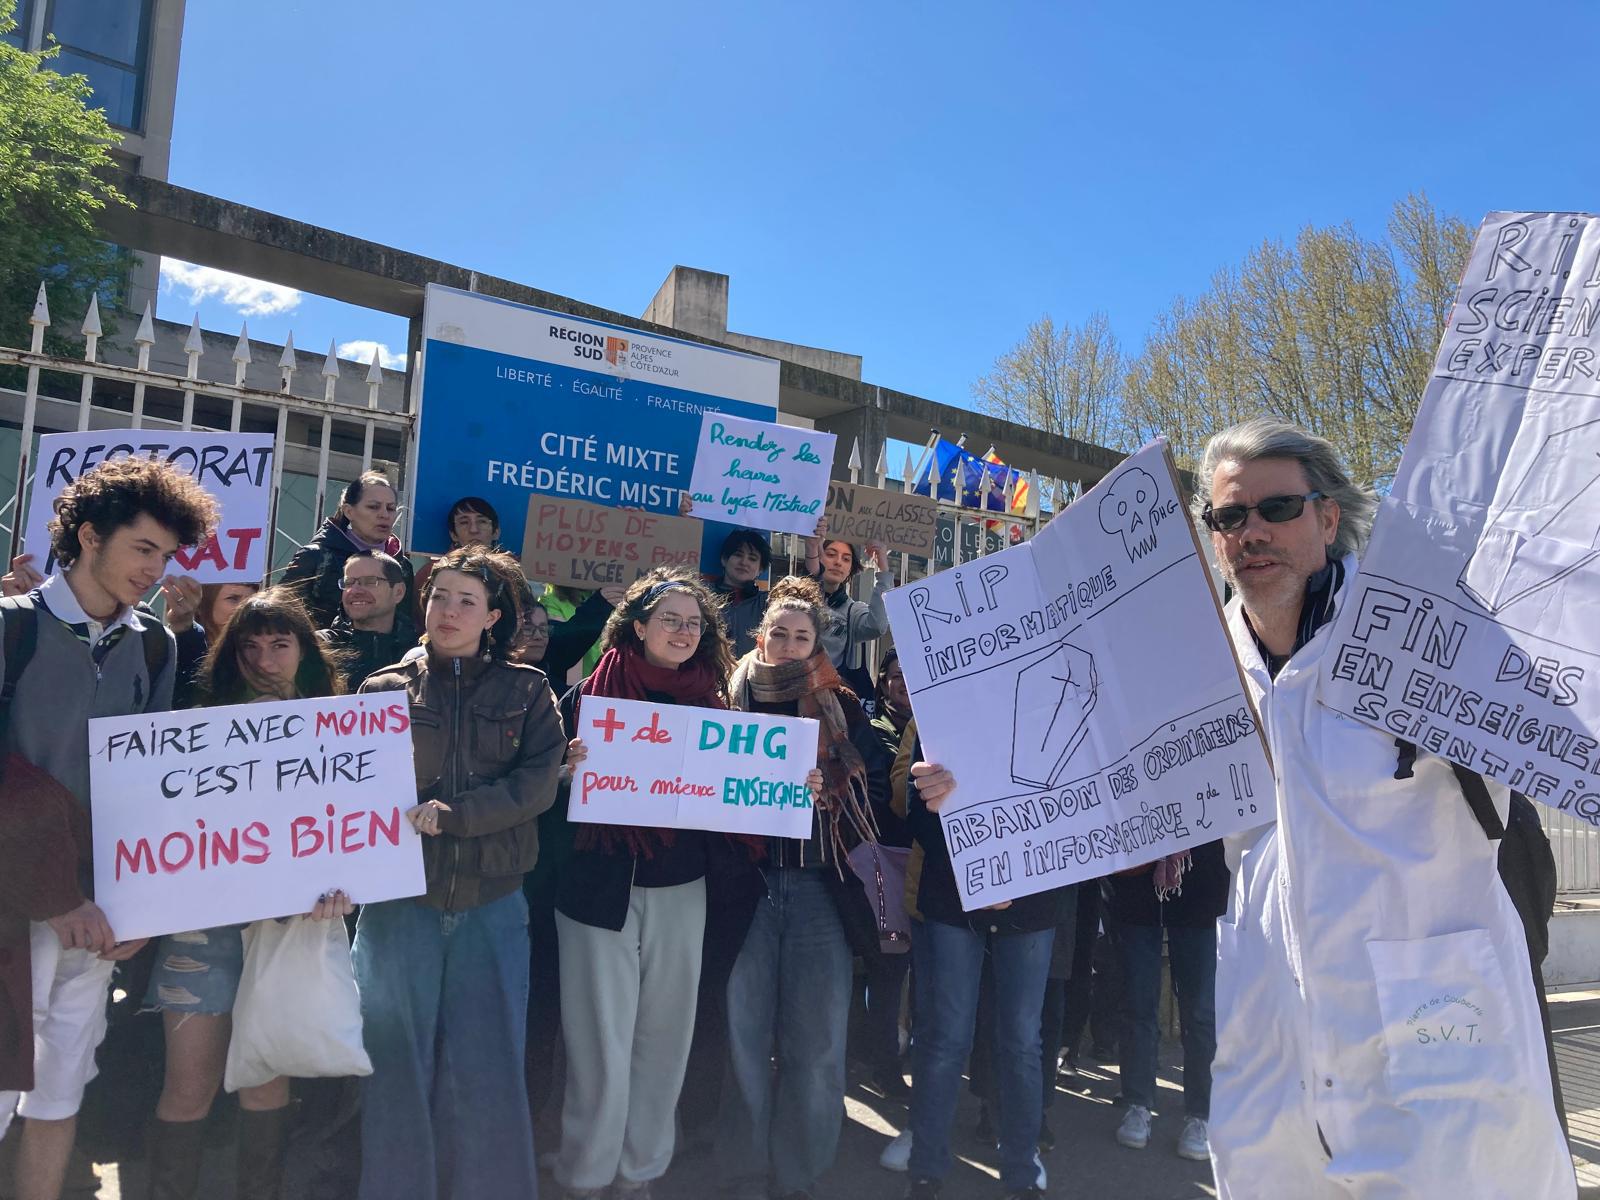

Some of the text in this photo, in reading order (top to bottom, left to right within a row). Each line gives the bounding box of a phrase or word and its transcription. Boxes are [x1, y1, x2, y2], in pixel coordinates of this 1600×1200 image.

[574, 345, 603, 361] SUD
[631, 342, 672, 359] PROVENCE
[631, 352, 653, 363] ALPES
[1447, 338, 1600, 383] EXPER
[496, 366, 552, 388] LIBERTÉ
[572, 380, 623, 401] ÉGALITÉ
[630, 360, 679, 378] CÔTE D'AZUR
[540, 432, 679, 476] CITÉ MIXTE
[710, 422, 821, 465] Rendez les
[487, 460, 611, 499] FRÉDÉRIC
[722, 459, 782, 485] heures
[692, 490, 715, 504] au
[763, 493, 821, 516] Mistral
[875, 501, 936, 526] CLASSES
[1152, 501, 1179, 527] DHG
[538, 504, 658, 538] PLUS DE
[536, 532, 640, 561] MOYENS
[535, 561, 557, 577] LE
[571, 559, 625, 584] LYCÉE
[1331, 643, 1393, 691] EN
[1495, 643, 1585, 707] DES
[224, 714, 305, 747] AVEC
[631, 711, 673, 744] de
[698, 719, 787, 760] DHG
[160, 759, 261, 799] C'EST
[649, 776, 716, 797] mieux
[946, 781, 1101, 858] ABANDON
[1108, 764, 1139, 800] DES
[966, 850, 1013, 896] EN
[1416, 1023, 1482, 1044] S.V.T.
